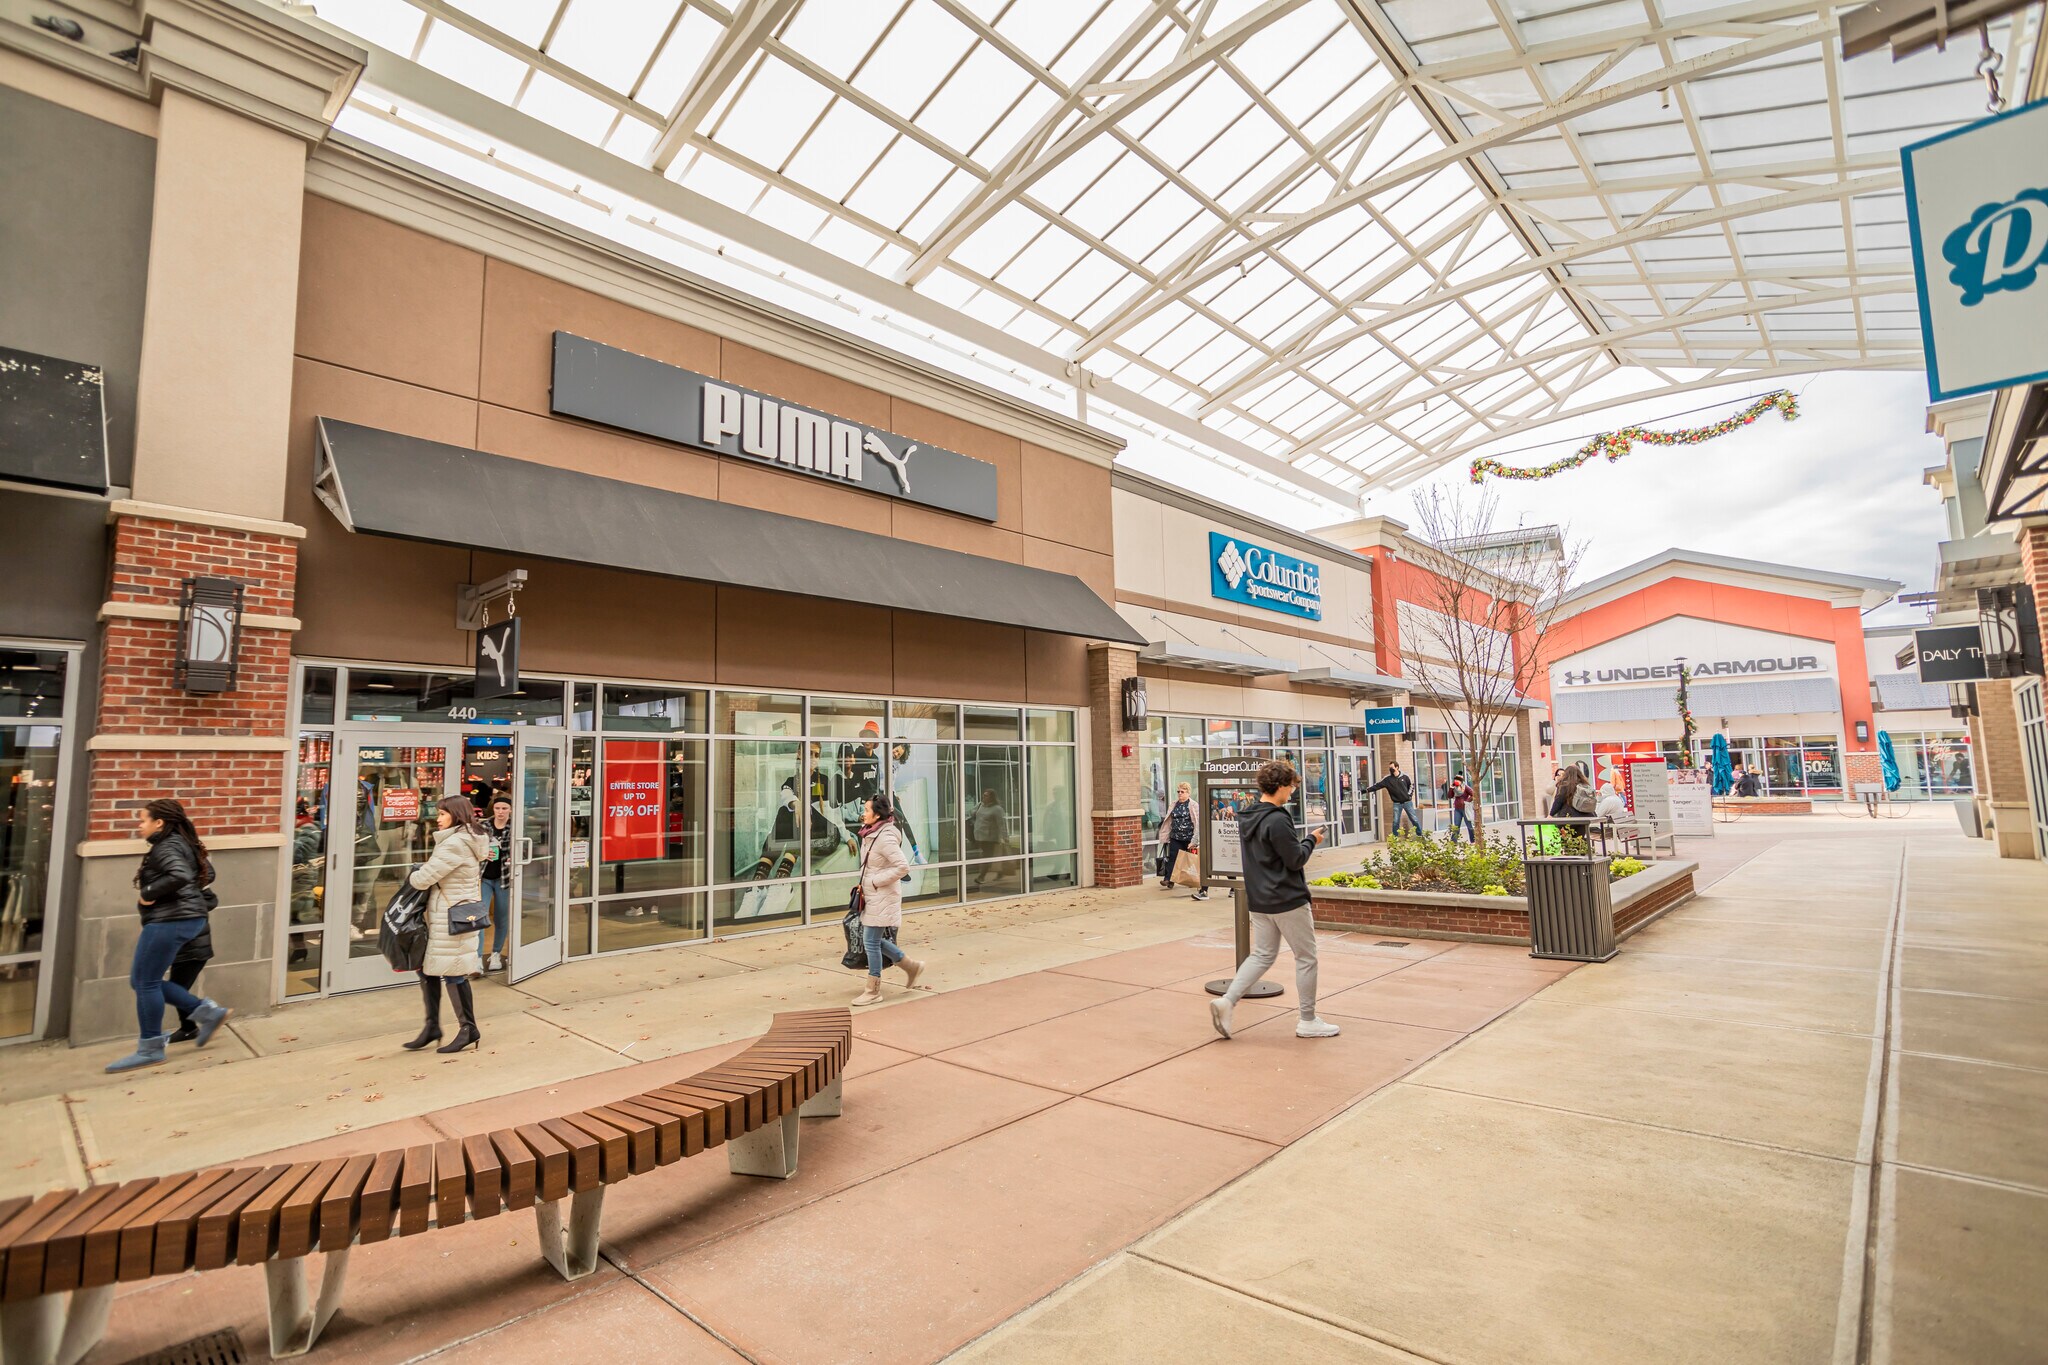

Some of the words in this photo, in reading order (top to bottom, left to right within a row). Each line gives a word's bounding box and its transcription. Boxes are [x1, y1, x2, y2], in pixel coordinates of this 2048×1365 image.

[704, 382, 862, 481] PUMA
[1244, 548, 1321, 597] Columbia
[1246, 579, 1290, 603] Sportswear
[1289, 590, 1321, 614] Company
[1922, 648, 1961, 662] DAILY
[1597, 664, 1682, 682] UNDER
[1693, 656, 1818, 676] ARMOUR
[448, 706, 477, 720] 440
[1375, 717, 1400, 725] Columbia
[476, 751, 499, 760] KIDS
[1204, 761, 1266, 774] TangerOutle
[610, 782, 636, 790] ENTIRE
[636, 781, 660, 789] STORE
[635, 792, 646, 800] TO
[609, 805, 635, 817] 75%
[637, 805, 660, 816] OFF
